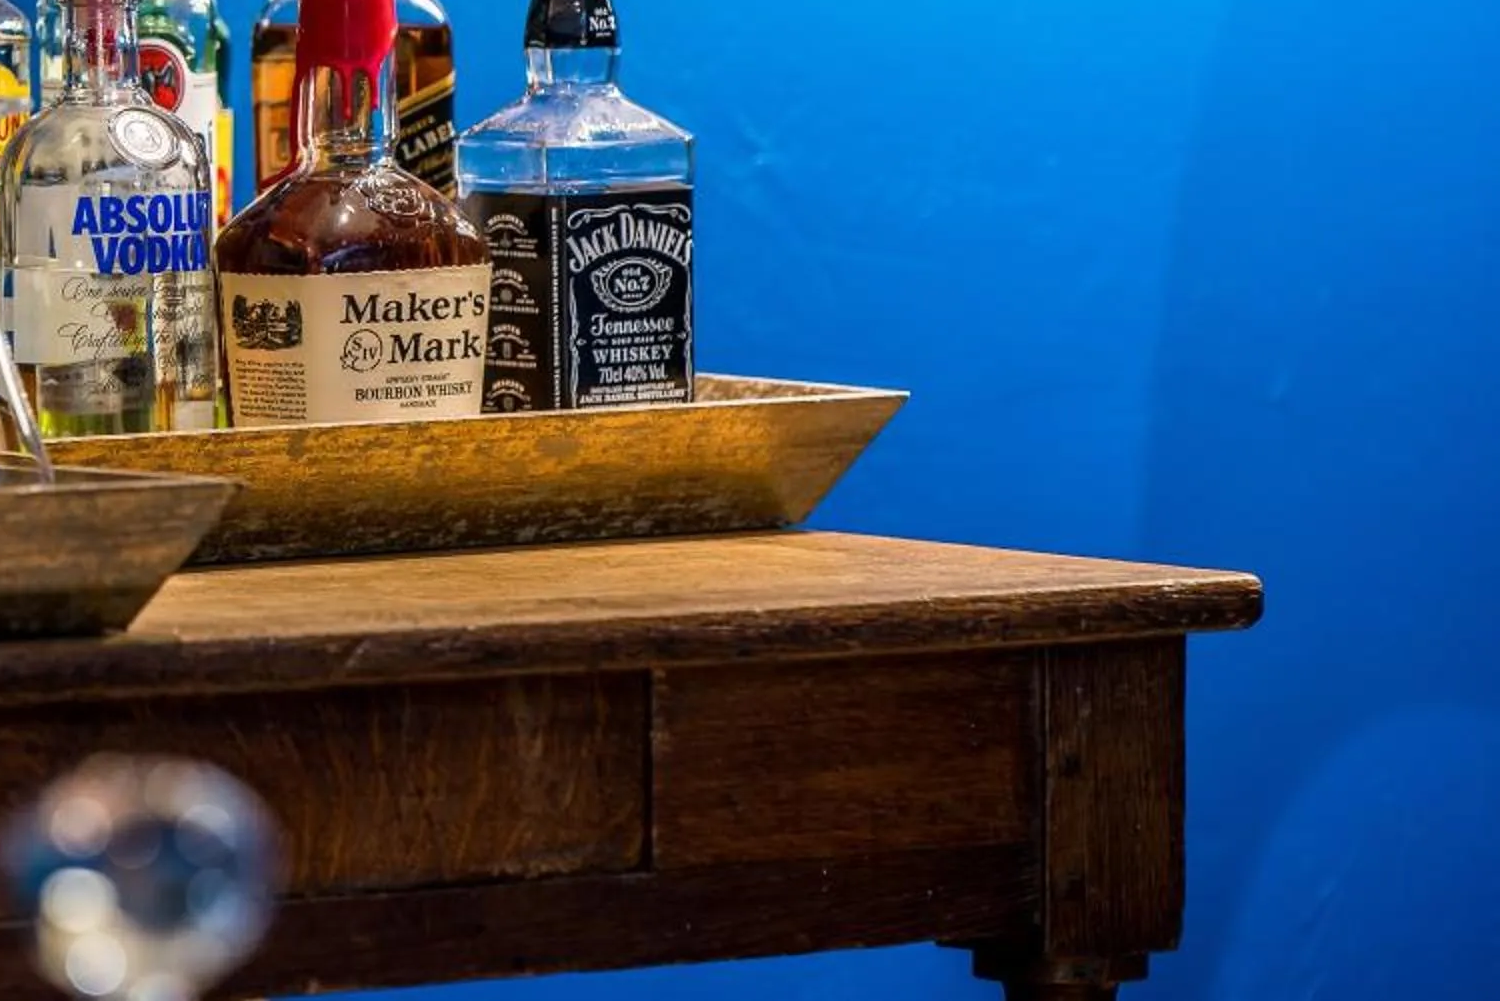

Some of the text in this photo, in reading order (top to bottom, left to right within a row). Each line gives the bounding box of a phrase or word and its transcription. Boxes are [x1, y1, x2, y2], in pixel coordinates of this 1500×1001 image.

[91, 234, 209, 276] VODKA
[566, 222, 620, 273] JACK
[620, 212, 695, 266] DANIEL'S
[340, 290, 485, 324] Maker's
[590, 313, 675, 337] Tennessee
[387, 329, 482, 364] Mark
[592, 344, 674, 364] WHISKEY
[355, 384, 423, 401] BOURBON
[426, 380, 473, 397] WHISKY
